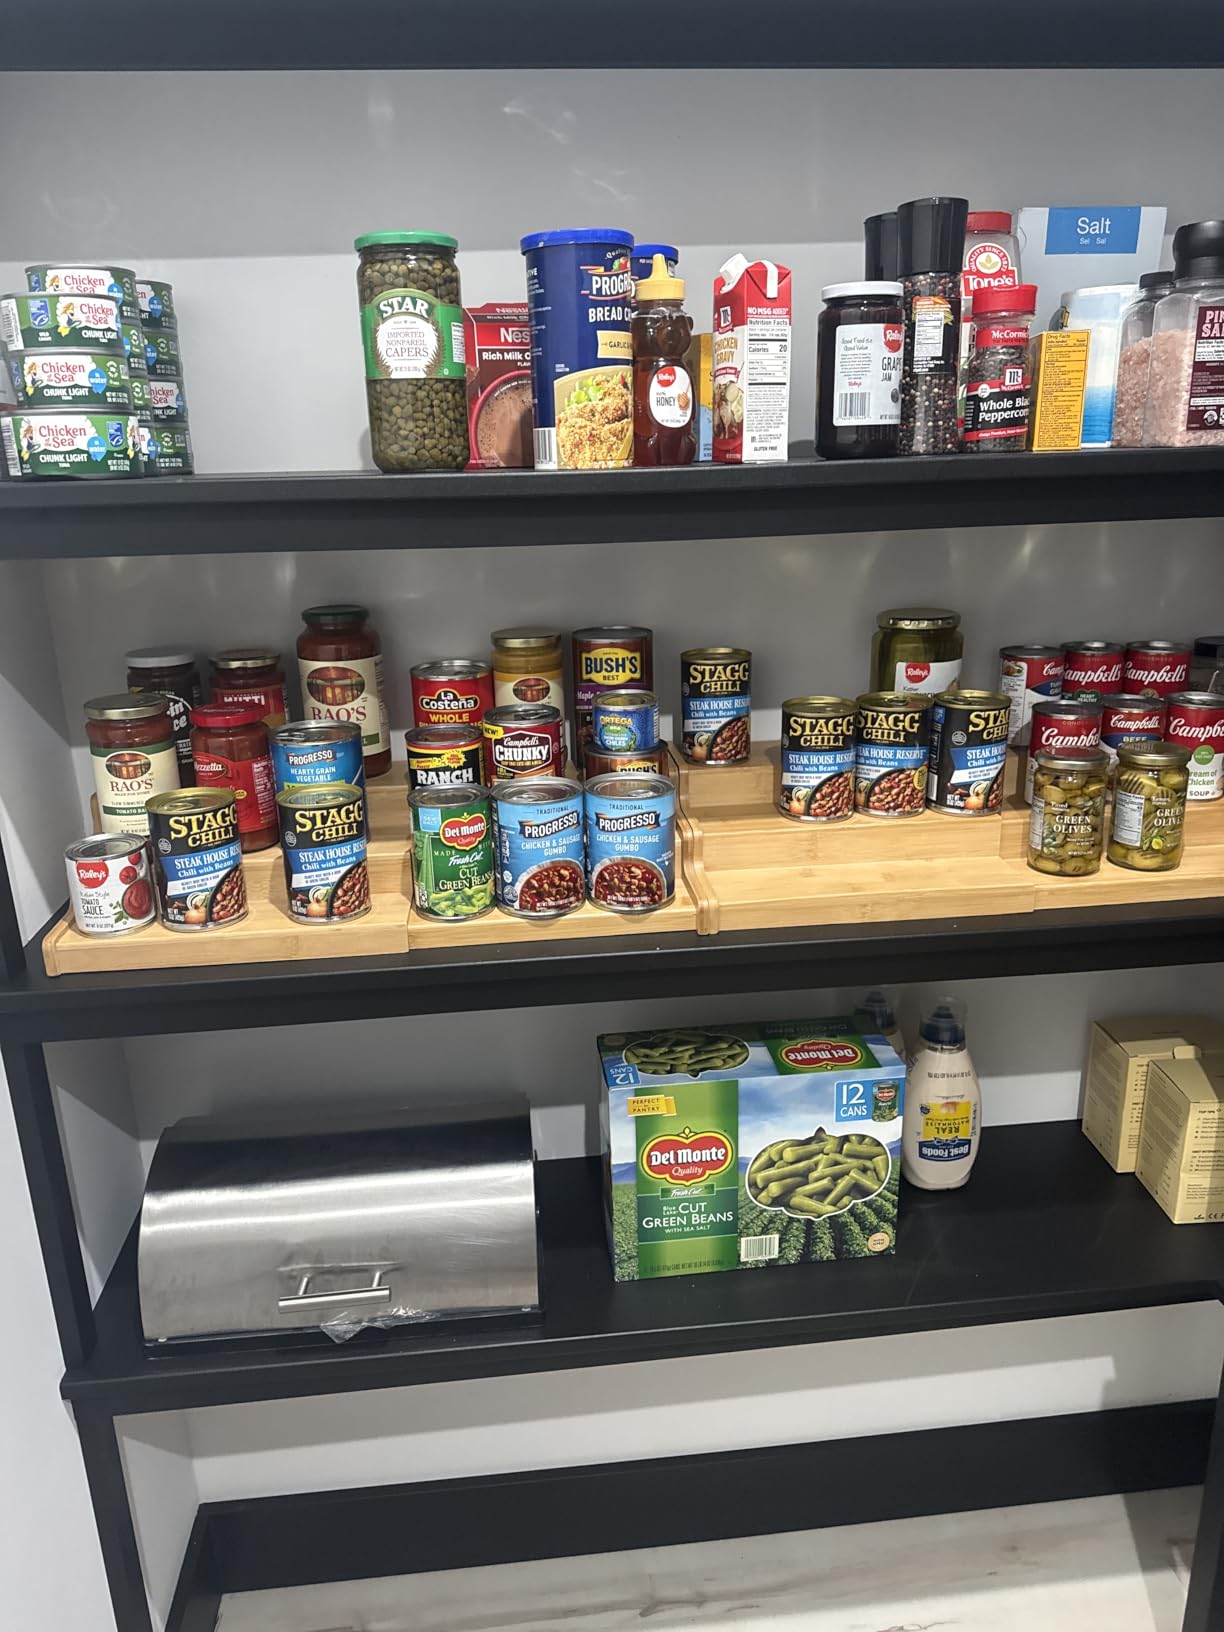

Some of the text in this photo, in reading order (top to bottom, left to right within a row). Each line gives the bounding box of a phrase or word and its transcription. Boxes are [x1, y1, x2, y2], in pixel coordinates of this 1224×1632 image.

[1076, 217, 1111, 235] Salt
[970, 247, 985, 272] QUALITY
[985, 246, 1003, 258] SINCE
[63, 275, 105, 288] Chicken
[592, 271, 631, 296] PROGR
[964, 274, 1014, 291] Tone's
[80, 303, 114, 318] Chicken
[379, 296, 430, 318] STAR
[747, 307, 772, 315] NO MSG
[92, 315, 109, 326] Sea
[588, 306, 623, 323] BREAD
[1205, 310, 1224, 323] PIN
[387, 331, 425, 339] IMPORTED
[500, 327, 531, 343] Nes
[1201, 323, 1224, 338] SAL
[386, 339, 427, 347] NONPAREIL
[714, 336, 738, 354] CHICKEN
[779, 344, 788, 353] 20
[385, 347, 429, 358] CAPERS
[482, 352, 500, 361] Rich
[504, 351, 521, 360] Milk
[716, 350, 735, 366] GRAVY
[41, 362, 85, 375] Chicken
[54, 373, 74, 384] Sea
[881, 372, 892, 382] JAM
[43, 388, 89, 396] CHUNK LIGHT
[153, 395, 168, 405] Sea
[656, 396, 676, 407] HONEY
[979, 398, 1014, 412] Whole
[38, 425, 86, 439] Chicken
[53, 437, 74, 448] Sea
[39, 453, 88, 463] CHUNK LIGHT
[584, 656, 638, 675] BUSH'S
[689, 662, 750, 685] STAGG
[907, 668, 929, 677] Raley's
[1124, 660, 1187, 685] Campbell's
[700, 680, 741, 693] CHILI
[440, 691, 454, 700] La
[576, 691, 594, 701] Maple
[422, 698, 475, 711] Costeña
[689, 700, 734, 711] STEAK HOUSE
[311, 705, 367, 722] RAO'S
[429, 713, 470, 723] WHOLE
[599, 716, 634, 726] ORTEGA
[789, 715, 855, 737] STAGG
[855, 709, 921, 733] STAGG
[1110, 713, 1161, 732] Campbell's
[1168, 716, 1224, 742] Campbe
[503, 735, 540, 748] Campbell's
[800, 735, 845, 747] CHILI
[862, 728, 906, 743] CHILI
[1040, 726, 1100, 748] Campbe
[605, 739, 626, 747] CHILES
[288, 749, 333, 766] PROGRESSO
[495, 744, 549, 761] CHUNKY
[870, 748, 925, 760] HOUSE RESERVE
[966, 747, 990, 760] STEAK
[788, 753, 835, 765] STEAK HOUSE
[878, 759, 898, 767] Beans
[967, 759, 985, 768] Chili
[195, 762, 223, 772] ezzetta
[290, 766, 336, 775] HEARTY GRAIN
[789, 764, 804, 772] Chili
[1210, 769, 1217, 777] of
[295, 774, 332, 782] VEGETABLE
[416, 767, 474, 785] RANCH
[110, 778, 153, 792] RAO'S
[536, 805, 570, 816] TRADITIONAL
[609, 803, 645, 811] TRADITIONAL
[168, 803, 238, 840] STAGG
[294, 799, 364, 834] STAGG
[599, 811, 656, 832] PROGRESSO
[1056, 814, 1091, 825] GREEN
[444, 822, 485, 838] Del Monte
[524, 812, 579, 838] PROGRESSO
[1053, 824, 1092, 834] OLIVES
[187, 826, 235, 848] CHILI
[311, 823, 358, 843] CHILI
[596, 833, 660, 844] CHICKEN & SAUSAGE
[457, 836, 477, 845] Quality
[521, 840, 552, 850] CHICKEN
[558, 833, 581, 846] SAUSAGE
[543, 847, 567, 857] GUMBO
[614, 843, 640, 853] GUMBO
[174, 853, 203, 870] STEAK
[203, 848, 230, 864] HOUSE
[298, 846, 352, 863] STEAK HOUSE
[448, 851, 484, 867] Fresh Cut
[177, 859, 234, 878] Chili with Beans
[301, 855, 357, 872] Chili with Beans
[79, 869, 106, 880] Raley's
[459, 867, 479, 879] CUT
[439, 871, 494, 891] GREEN BEANS
[80, 898, 100, 906] TOMATO
[82, 905, 105, 916] SAUCE
[788, 1048, 856, 1060] Del Monte
[609, 1066, 634, 1075] CANS
[614, 1073, 636, 1084] 12
[840, 1083, 866, 1105] 12
[632, 1098, 660, 1106] PERFECT
[632, 1105, 660, 1113] PANTRY
[840, 1105, 867, 1118] CANS
[925, 1119, 970, 1127] MAYONNAISE
[935, 1126, 960, 1134] REAL
[650, 1145, 726, 1167] Del Monte
[921, 1145, 969, 1157] Best Foods
[671, 1166, 704, 1178] Quality
[671, 1188, 703, 1198] Fresh Cut
[678, 1202, 708, 1214] CUT
[642, 1211, 734, 1229] GREEN BEANS
